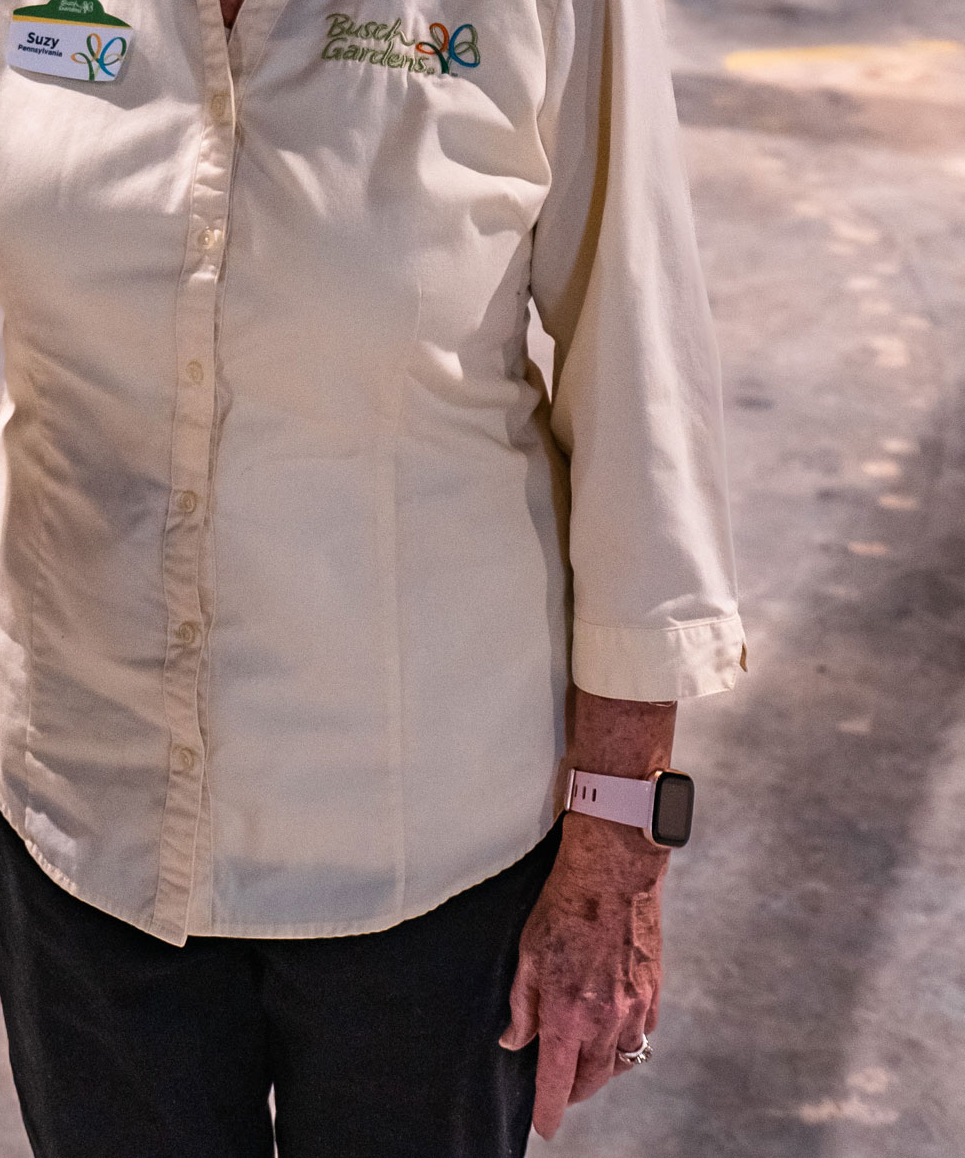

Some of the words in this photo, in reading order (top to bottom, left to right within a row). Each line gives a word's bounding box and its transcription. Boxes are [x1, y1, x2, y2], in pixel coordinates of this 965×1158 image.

[325, 13, 416, 46] Busch
[17, 43, 63, 57] Pennsylvania
[26, 31, 60, 50] Suzy
